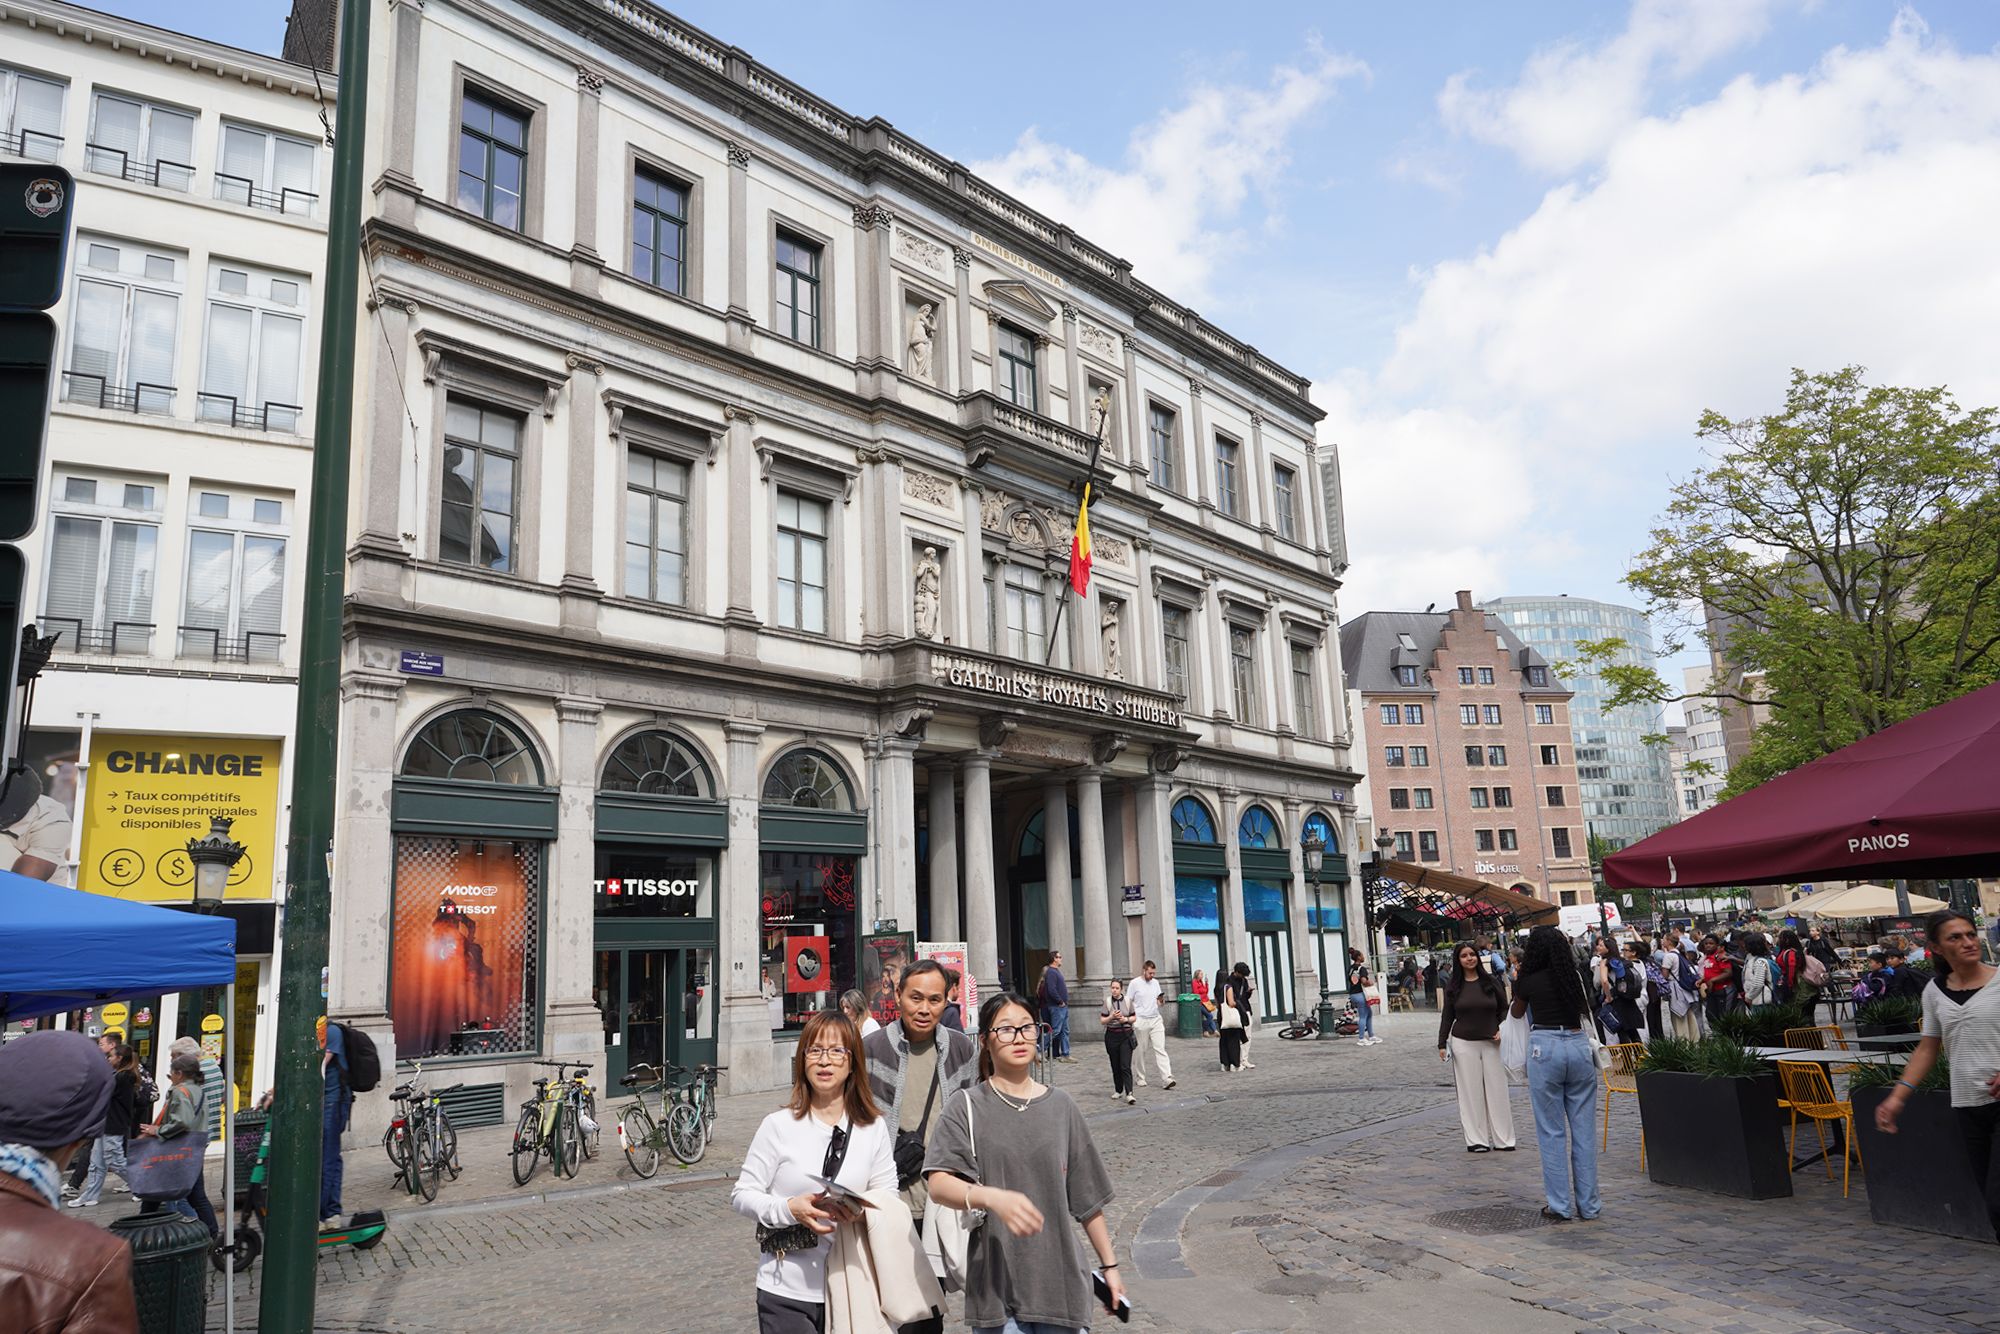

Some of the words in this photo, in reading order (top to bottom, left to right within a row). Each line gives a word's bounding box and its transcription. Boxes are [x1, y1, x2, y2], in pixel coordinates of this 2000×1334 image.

[974, 234, 1025, 268] OMNIBUS
[1027, 261, 1061, 287] OMNIA
[950, 667, 1032, 698] GALERIES
[1042, 685, 1108, 713] ROYALES
[1132, 704, 1184, 727] HUBERT
[106, 750, 264, 777] CHANGE
[125, 790, 158, 801] Taux
[161, 792, 241, 804] compétitifs
[123, 804, 180, 815] Devises
[182, 806, 258, 818] principales
[120, 818, 202, 831] disponibles
[1847, 833, 1910, 853] PANOS
[1475, 861, 1496, 874] ibis
[1496, 864, 1520, 873] HOTEL
[440, 885, 498, 896] MotoGP
[623, 879, 699, 896] TISSOT
[456, 905, 497, 914] TISSOT
[879, 1000, 895, 1009] THE
